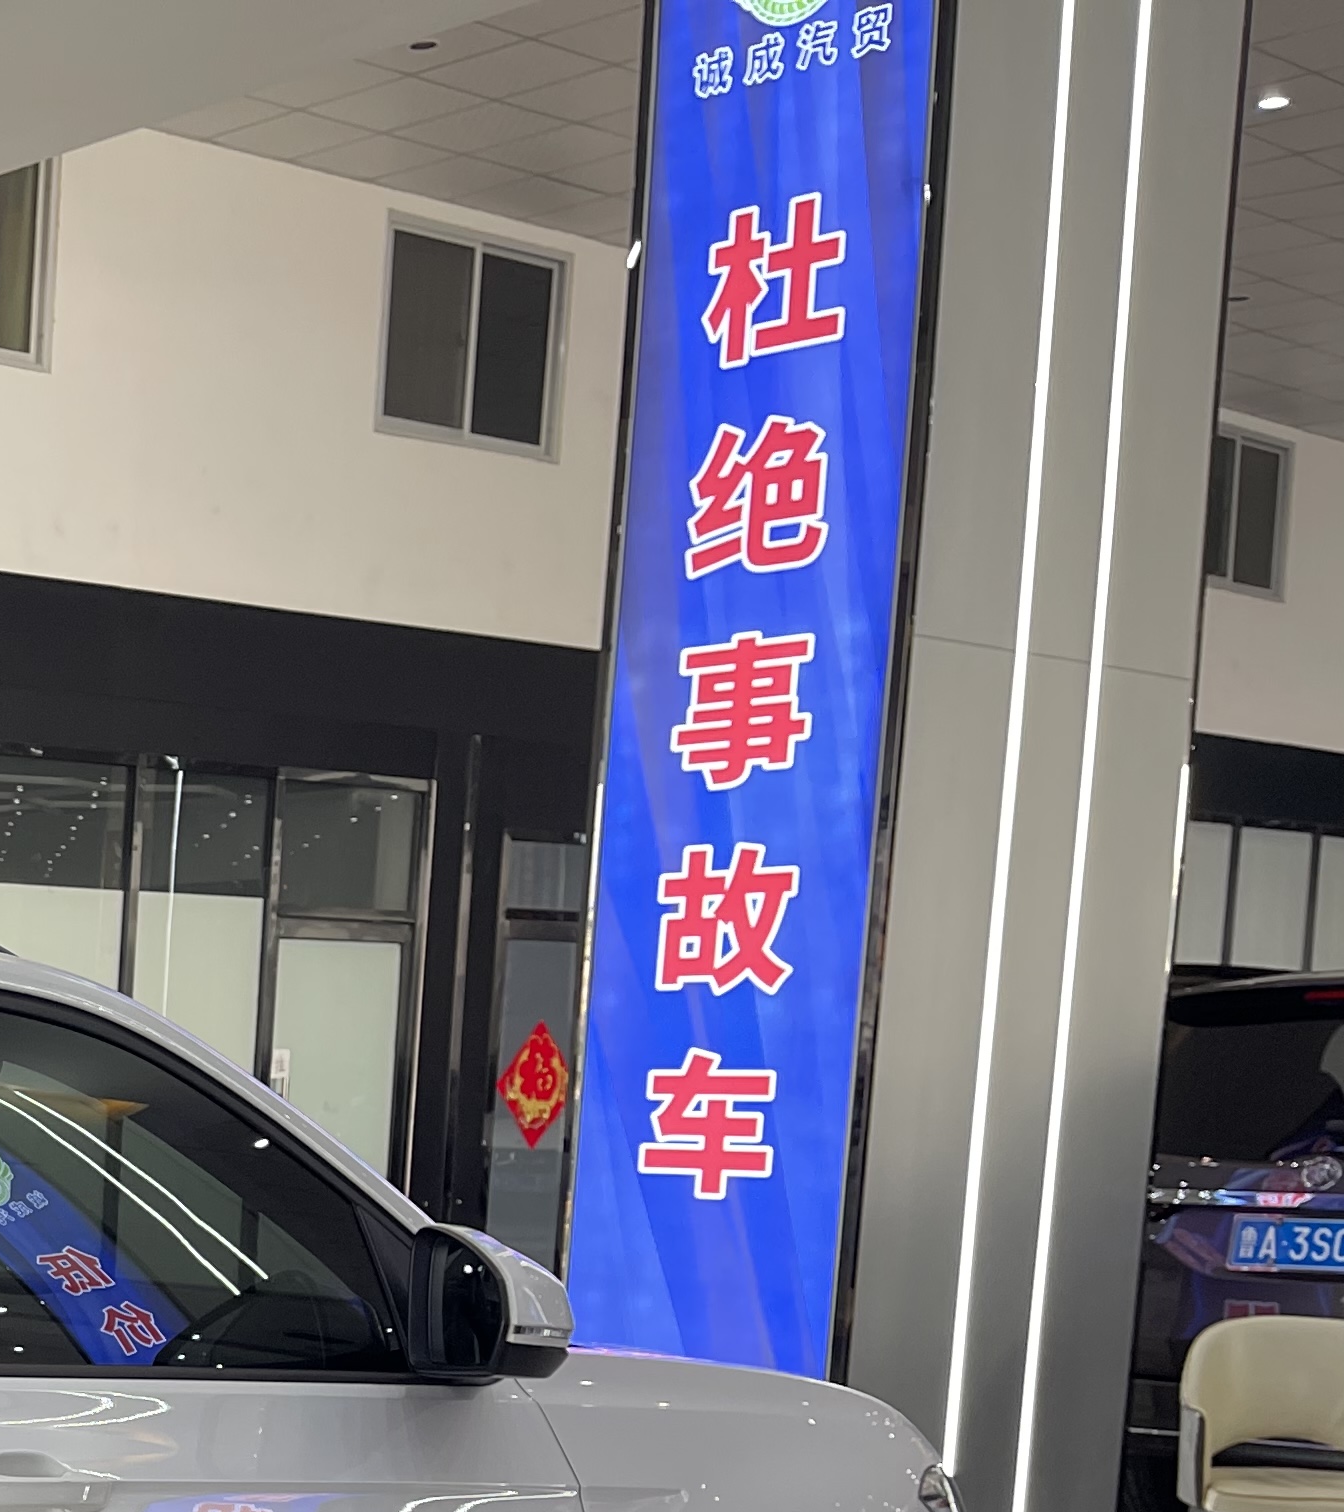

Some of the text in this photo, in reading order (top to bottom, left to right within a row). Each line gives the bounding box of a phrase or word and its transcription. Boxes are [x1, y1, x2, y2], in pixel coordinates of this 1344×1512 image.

[693, 3, 894, 98] 诚成汽贸
[638, 191, 847, 1200] 杜绝事故车
